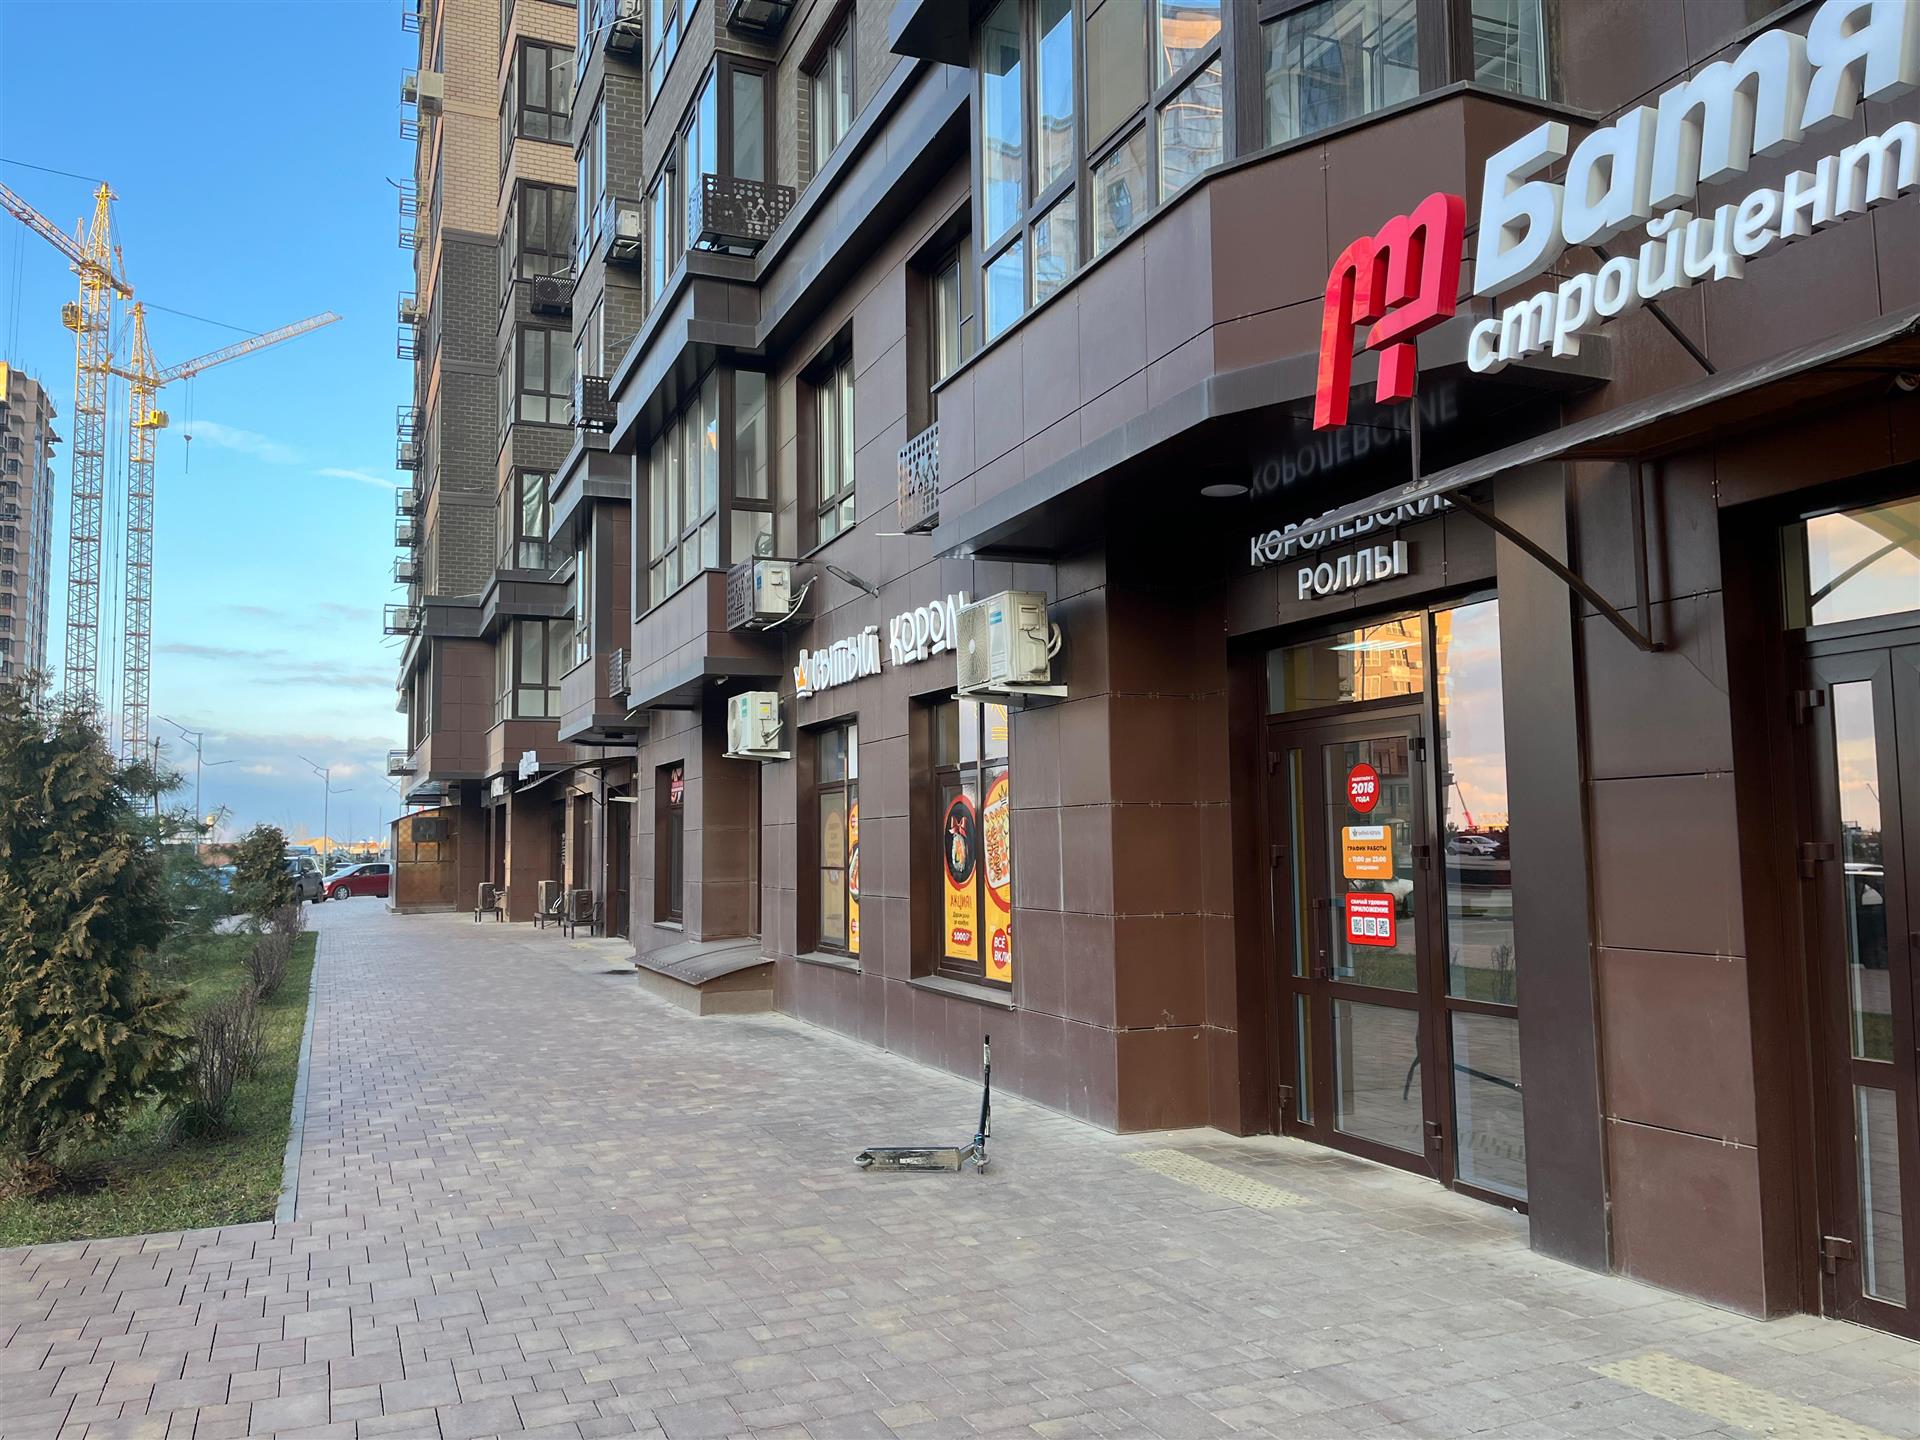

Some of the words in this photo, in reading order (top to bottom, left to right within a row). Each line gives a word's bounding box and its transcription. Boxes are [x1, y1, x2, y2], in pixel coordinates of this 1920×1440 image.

[1474, 0, 1920, 298] Батя
[1298, 539, 1409, 600] РОЛЛЫ
[1351, 781, 1374, 795] 2018
